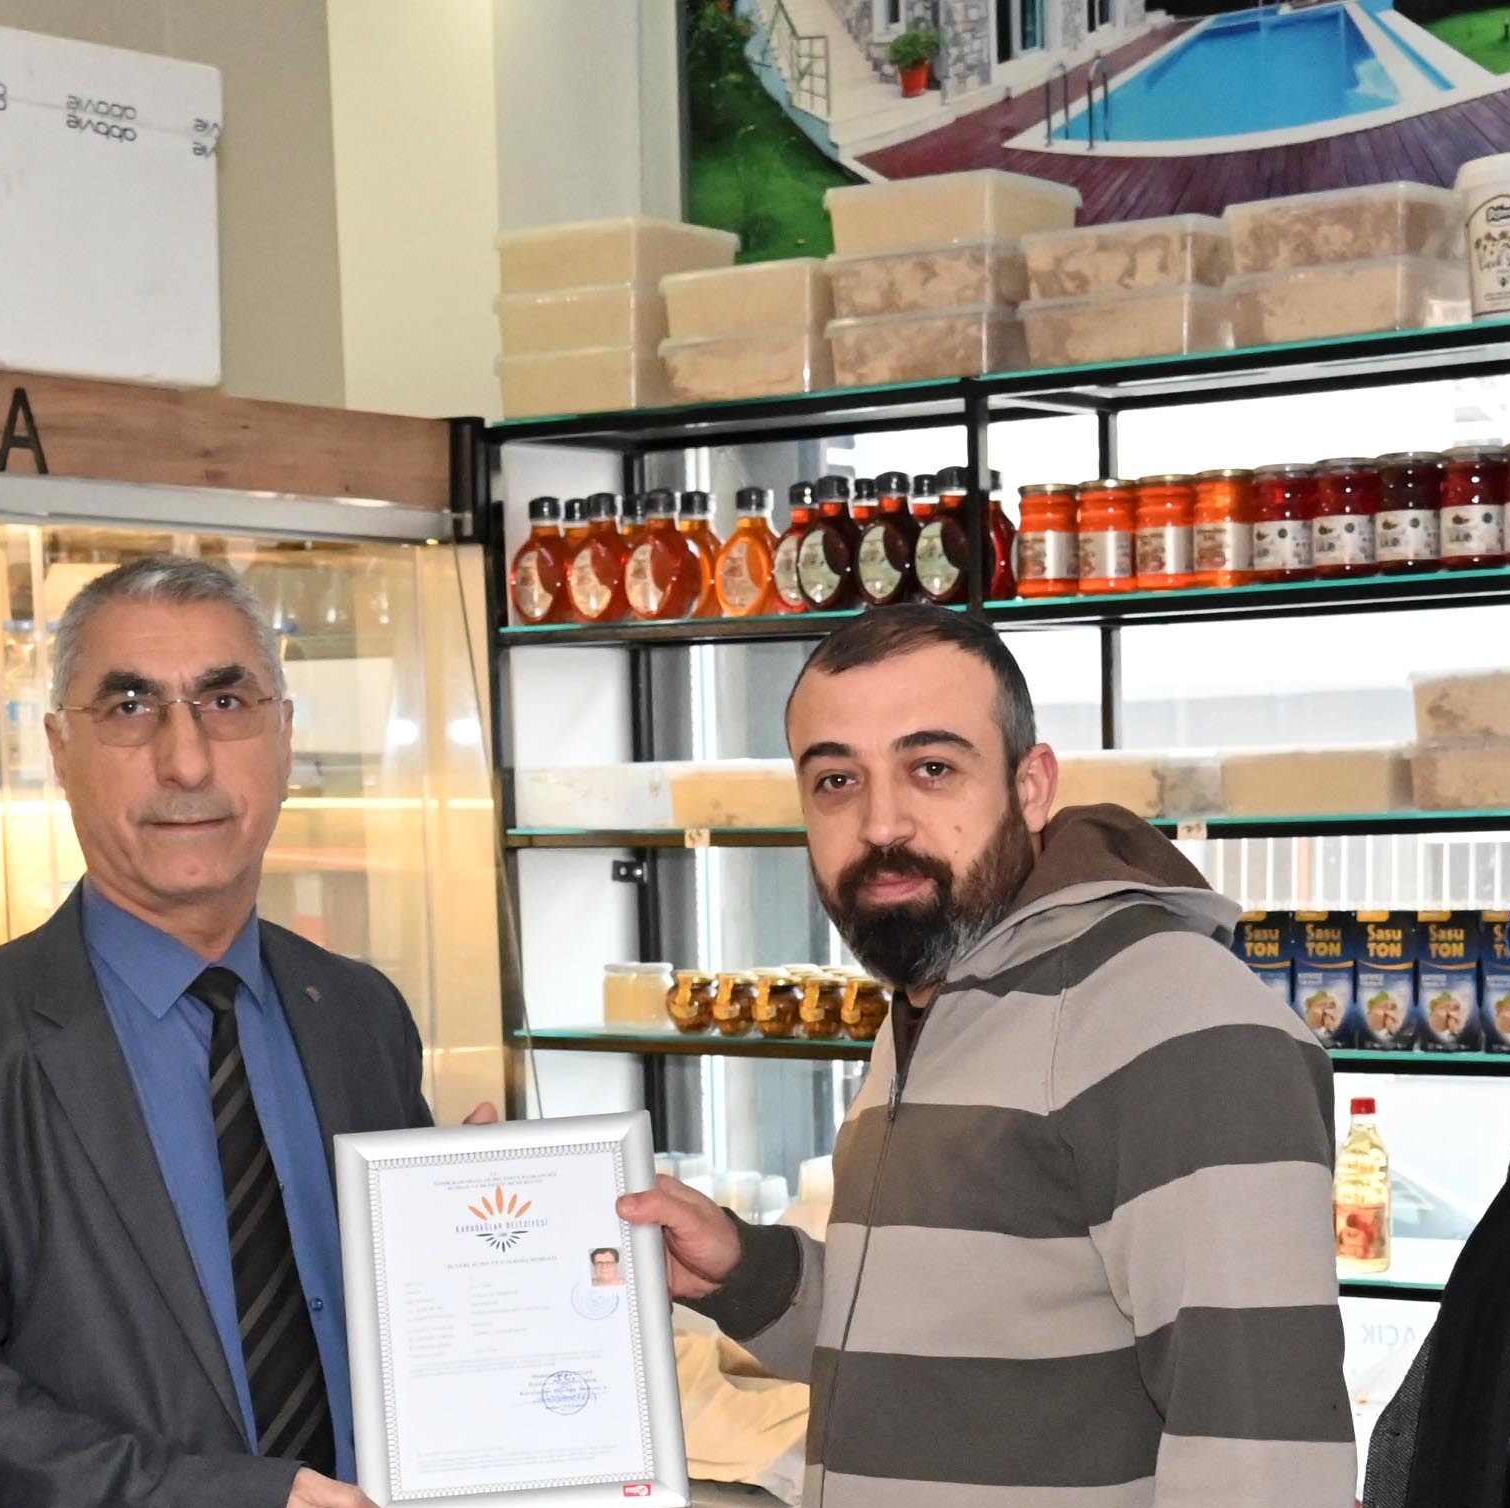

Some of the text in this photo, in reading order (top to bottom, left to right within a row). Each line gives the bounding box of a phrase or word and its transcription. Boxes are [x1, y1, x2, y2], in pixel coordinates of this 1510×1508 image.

[1245, 942, 1279, 957] TON
[1306, 942, 1341, 958] TON
[1367, 942, 1402, 958] TON
[1430, 942, 1464, 958] TON
